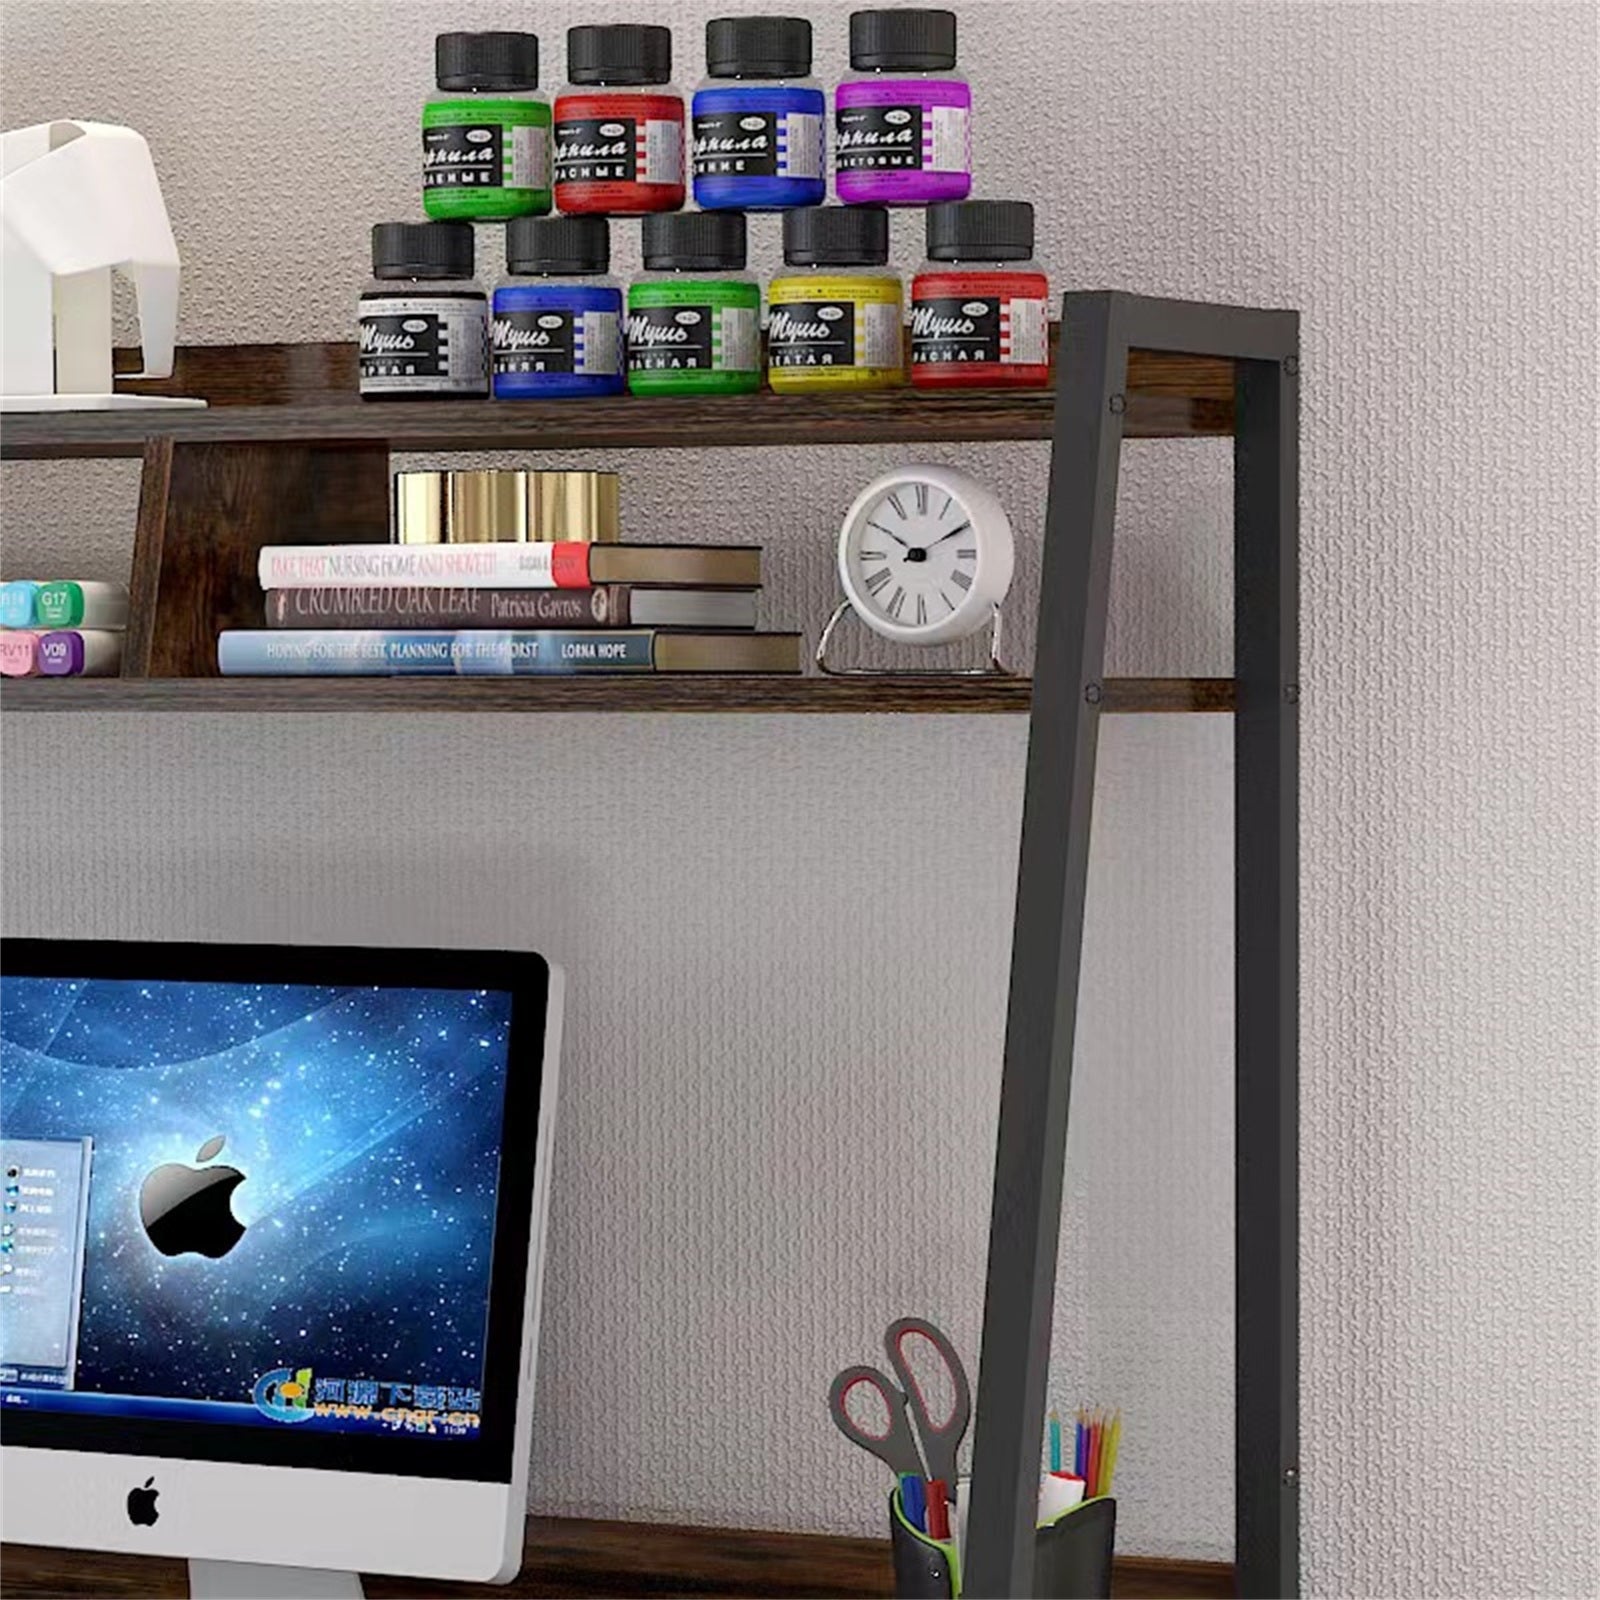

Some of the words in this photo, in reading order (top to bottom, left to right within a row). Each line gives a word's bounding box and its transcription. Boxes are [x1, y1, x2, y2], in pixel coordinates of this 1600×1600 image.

[299, 556, 327, 576] THAT
[328, 555, 380, 576] NURSING
[381, 555, 416, 576] HOME
[41, 592, 68, 606] G17
[491, 592, 536, 618] Patricia
[41, 643, 68, 657] V09
[390, 642, 448, 659] PLANNING
[561, 643, 596, 659] LORNA
[598, 643, 627, 659] HOPE
